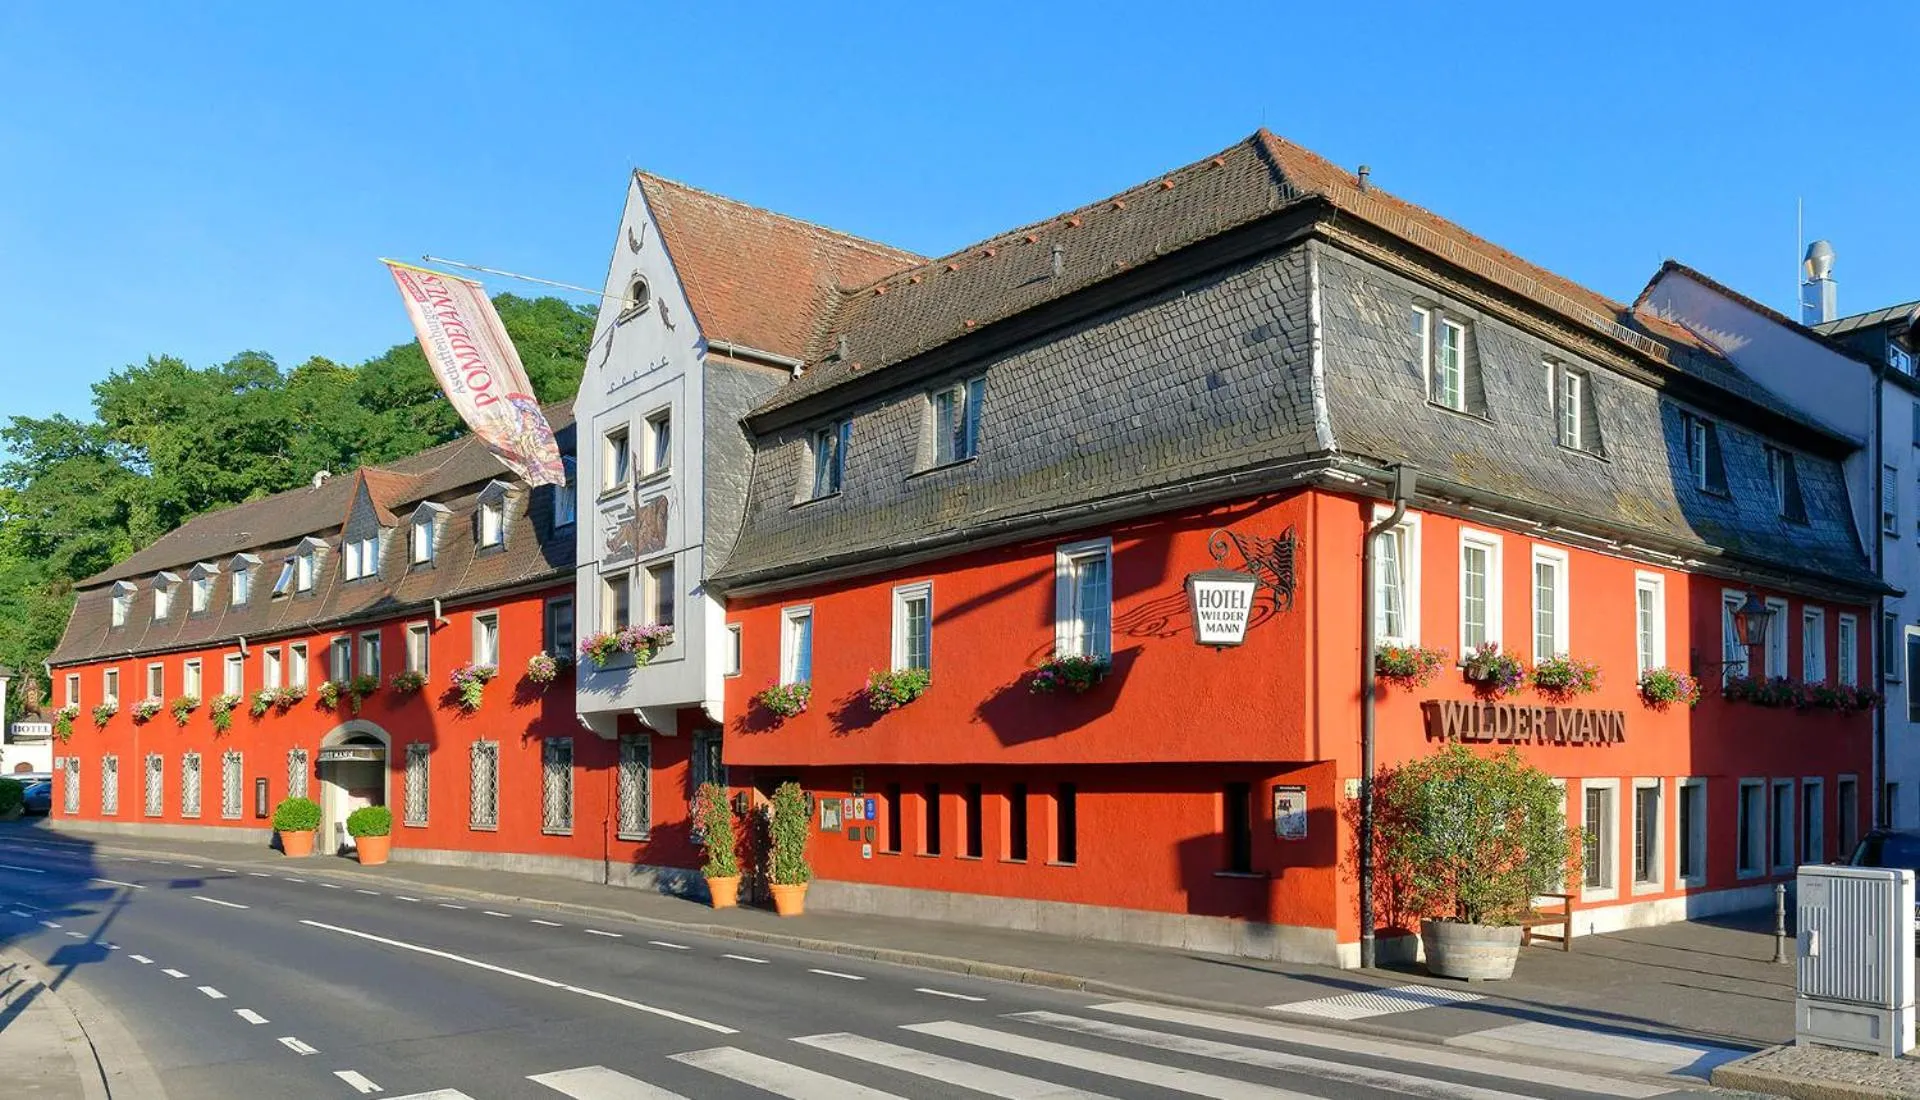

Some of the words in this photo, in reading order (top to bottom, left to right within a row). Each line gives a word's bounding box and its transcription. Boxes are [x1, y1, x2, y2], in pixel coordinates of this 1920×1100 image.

[420, 303, 467, 394] Aschaffenburger
[1199, 589, 1247, 609] HOTEL
[1201, 611, 1244, 621] WILDER
[1205, 623, 1240, 633] MANN
[1437, 700, 1548, 740] WILDER
[1555, 707, 1626, 744] MANN
